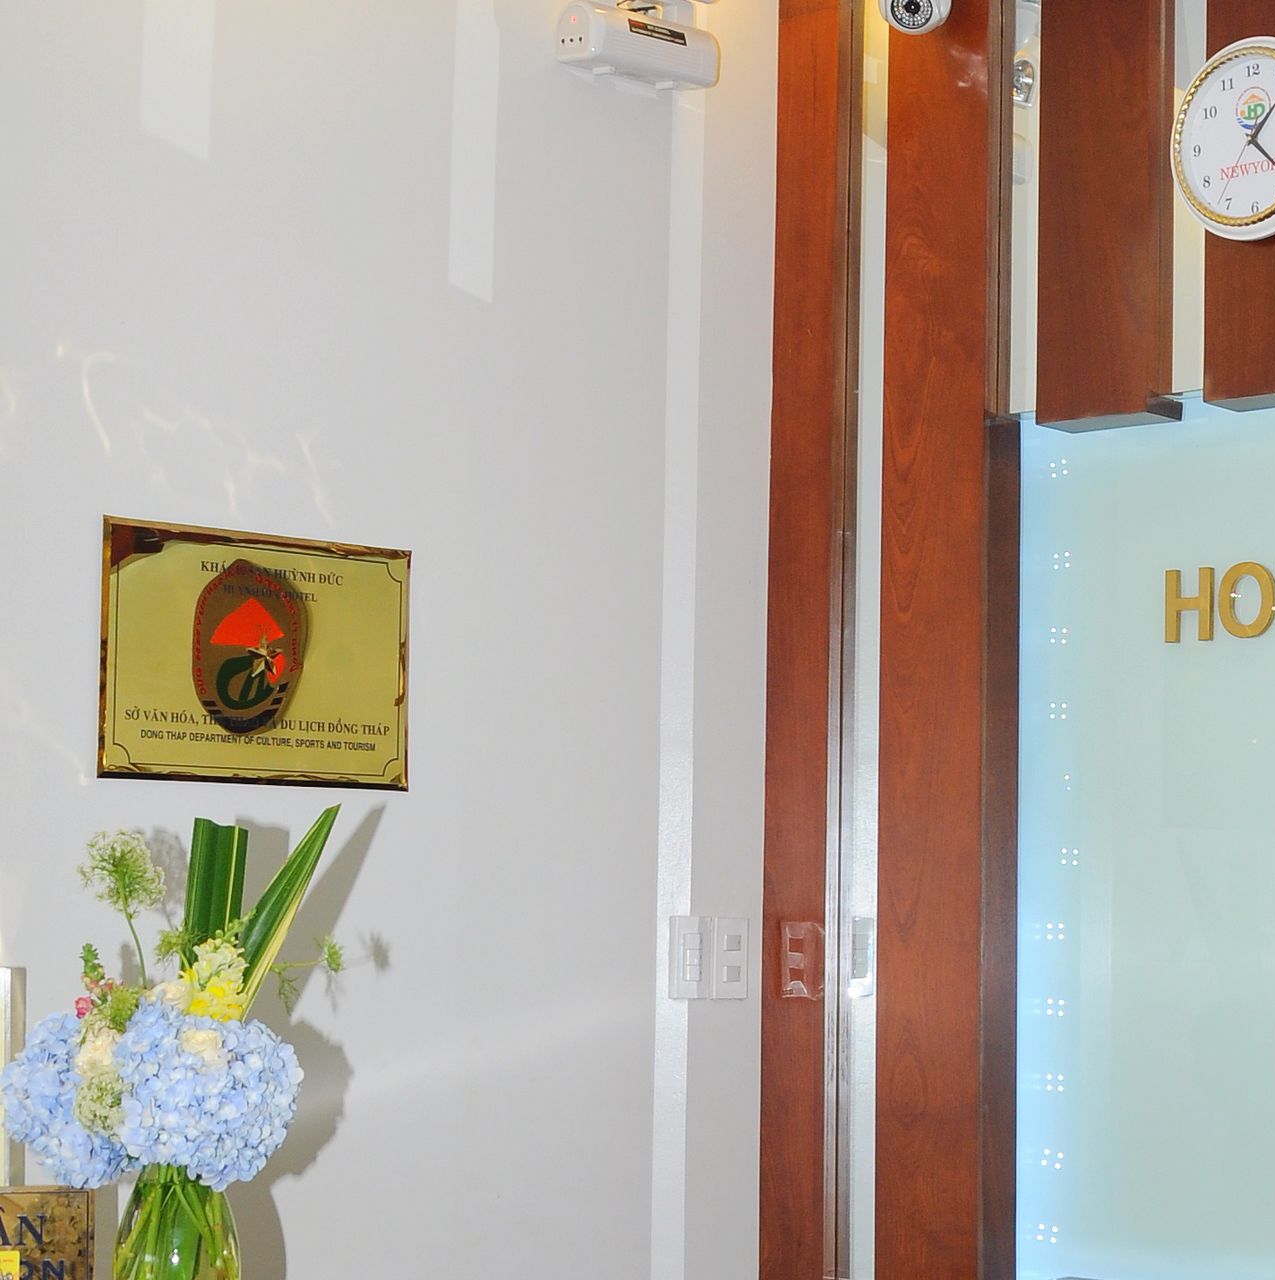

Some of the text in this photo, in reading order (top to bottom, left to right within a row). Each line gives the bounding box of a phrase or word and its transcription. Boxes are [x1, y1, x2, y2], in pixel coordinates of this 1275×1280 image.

[1246, 64, 1260, 77] 12
[1221, 79, 1234, 91] 11
[1203, 106, 1217, 119] 10
[1194, 145, 1201, 157] 9
[1203, 176, 1210, 188] 8
[1225, 198, 1232, 210] 7
[1251, 202, 1259, 213] 6
[319, 571, 344, 586] ĐỨC
[144, 708, 168, 722] VĂN
[171, 709, 199, 726] HÓA,
[280, 720, 296, 731] DU
[299, 720, 325, 734] LỊCH
[361, 722, 390, 737] THÁP
[140, 729, 376, 752] DONG THAP DEPARTMENT OF CULTURE, SPORTS AND TOURISM
